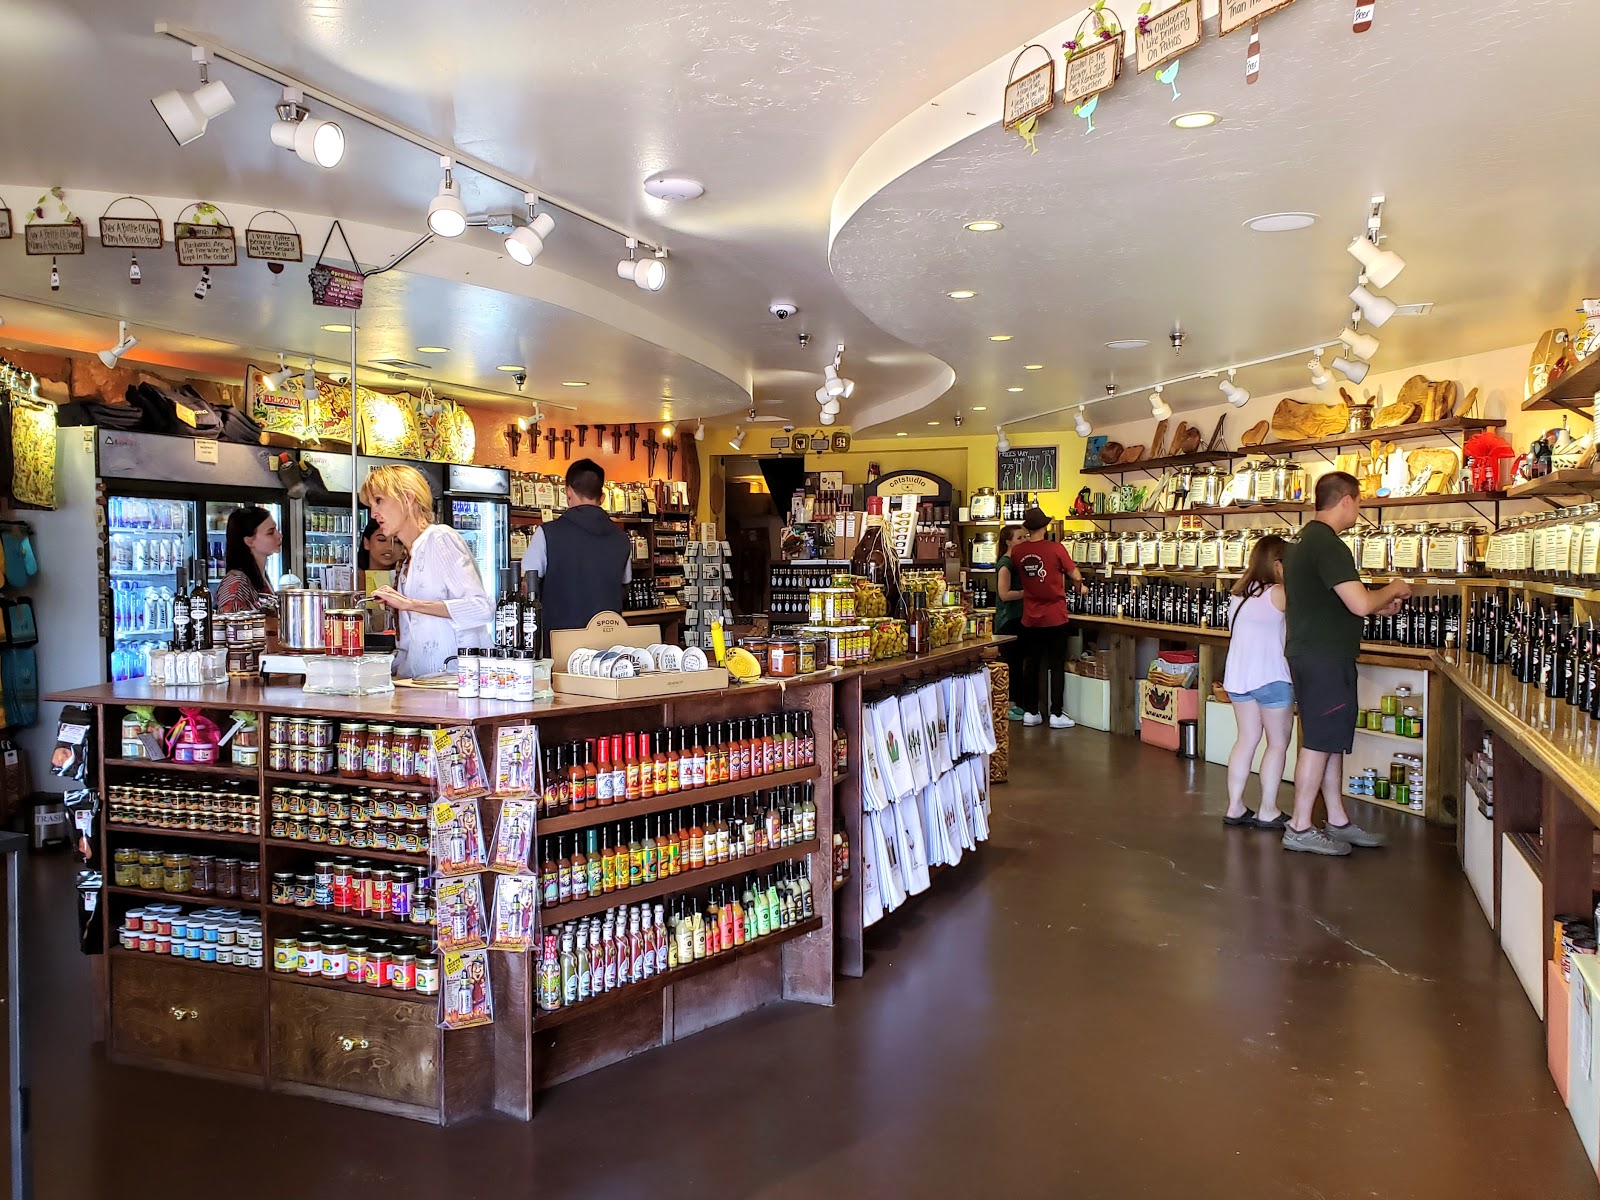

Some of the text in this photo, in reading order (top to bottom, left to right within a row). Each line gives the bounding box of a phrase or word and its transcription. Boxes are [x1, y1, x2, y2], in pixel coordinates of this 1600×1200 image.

[1154, 7, 1188, 32] Outdoorsy
[1355, 9, 1370, 21] Beer
[1146, 35, 1159, 49] Like
[1160, 17, 1191, 41] Drinking
[1147, 34, 1182, 61] On Patios
[263, 395, 299, 407] ARIZONA
[889, 476, 926, 488] catstudio
